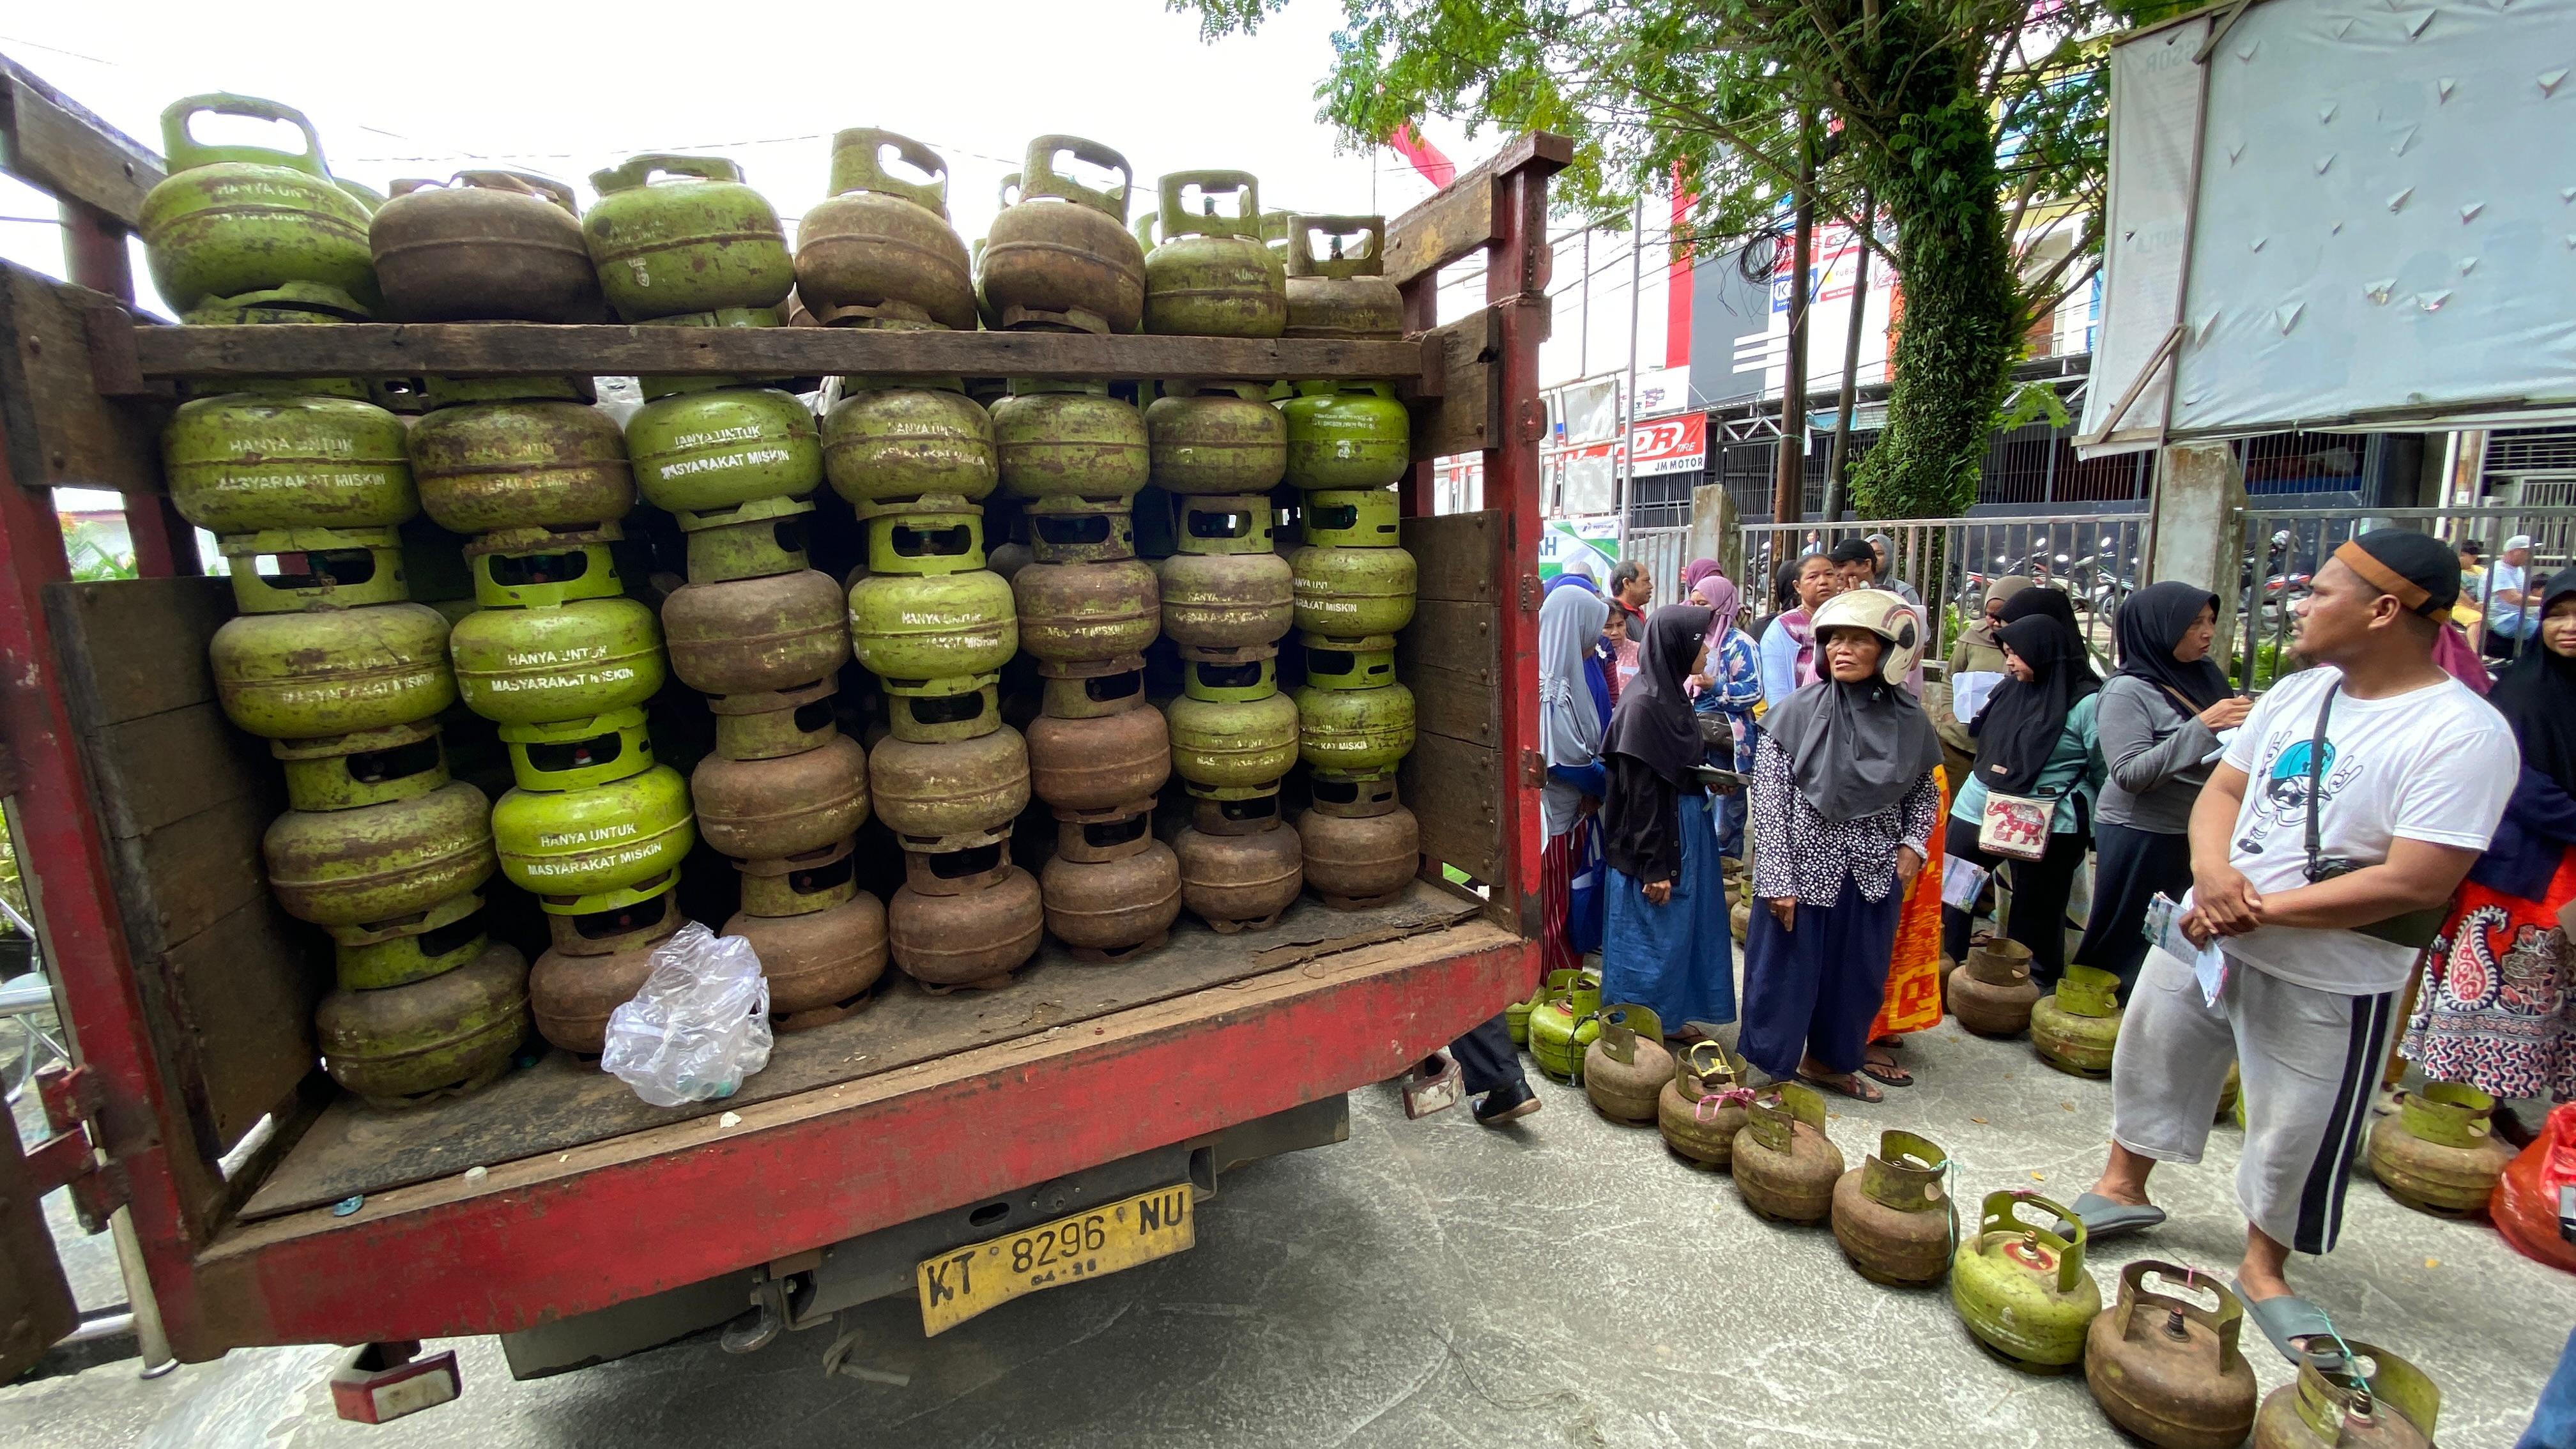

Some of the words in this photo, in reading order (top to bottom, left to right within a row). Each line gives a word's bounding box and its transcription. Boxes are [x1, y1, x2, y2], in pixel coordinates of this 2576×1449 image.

[1676, 441, 1696, 453] TIRE
[1655, 461, 1667, 472] JM
[1670, 456, 1703, 470] MOTOR
[1326, 602, 1358, 613] MISKIN
[508, 650, 557, 666] HANYA
[540, 833, 586, 847] HANYA
[590, 823, 637, 841] UNTUK
[527, 855, 617, 876] MASYARAKAT
[620, 841, 662, 864] MISKIN
[927, 1250, 976, 1308] KT
[1012, 1215, 1105, 1274] 8296
[1138, 1192, 1184, 1236] NU
